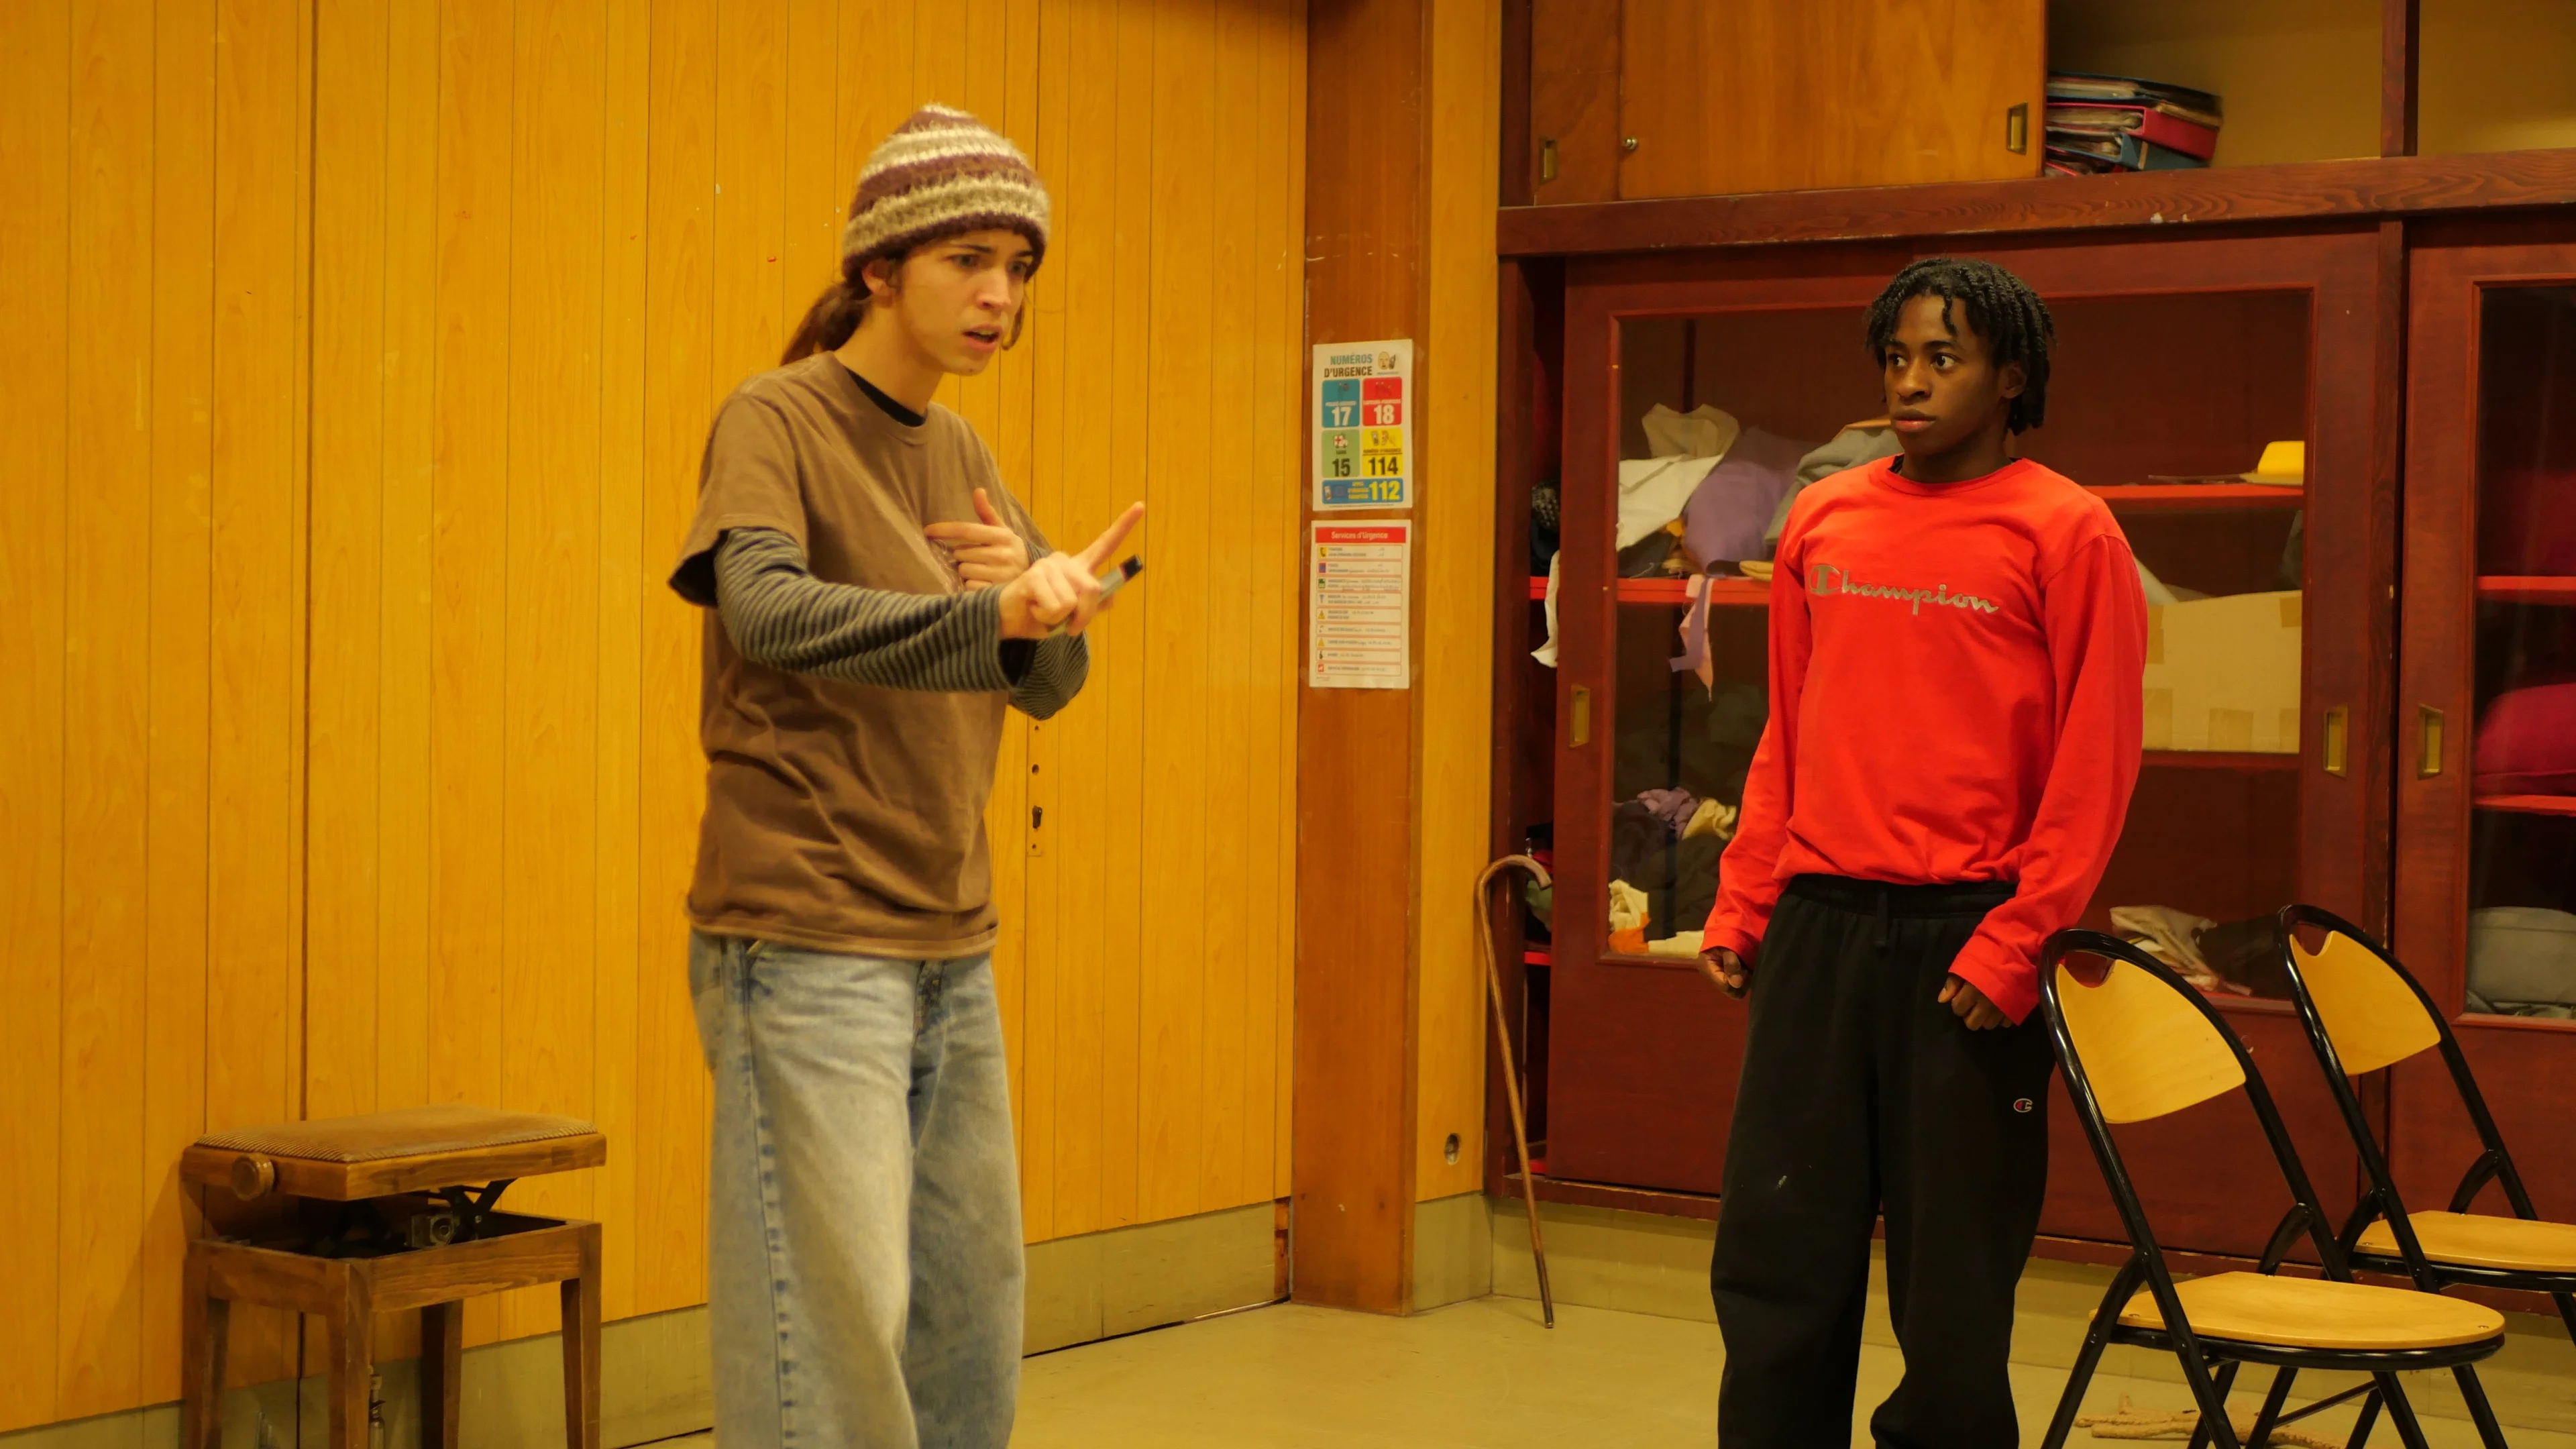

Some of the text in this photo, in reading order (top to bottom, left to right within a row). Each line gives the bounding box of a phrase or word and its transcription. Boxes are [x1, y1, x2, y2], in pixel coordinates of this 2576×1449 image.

[1330, 352, 1373, 366] NUMÉROS
[1324, 366, 1373, 378] D'URGENCE
[1332, 407, 1352, 426] 17
[1374, 405, 1395, 424] 18
[1332, 458, 1350, 477] 15
[1368, 457, 1398, 475] 114
[1369, 480, 1400, 500] 112
[1331, 531, 1355, 539] Services
[1809, 564, 1998, 614] Champion
